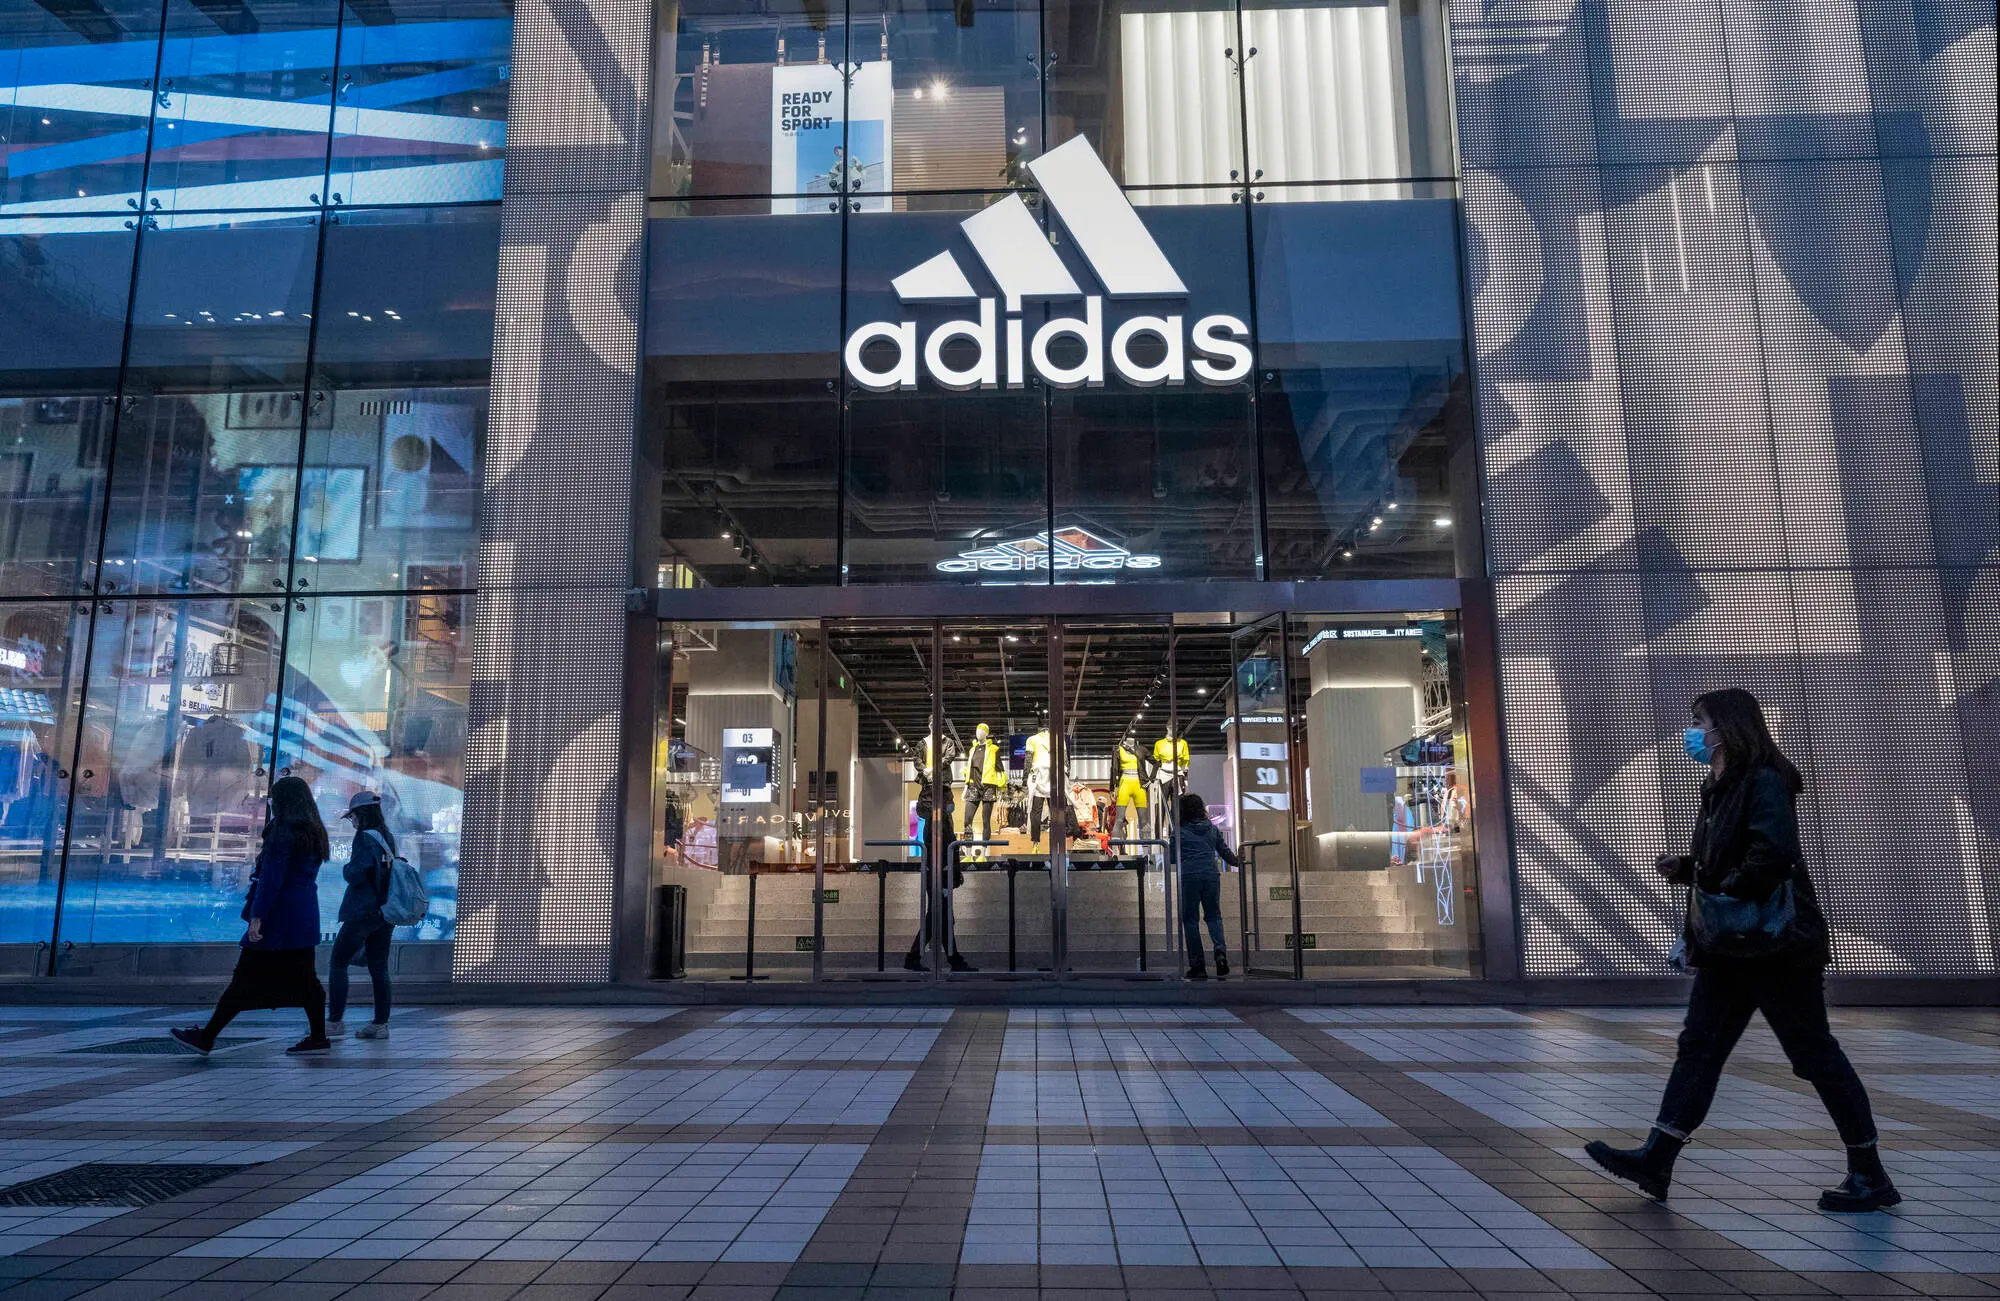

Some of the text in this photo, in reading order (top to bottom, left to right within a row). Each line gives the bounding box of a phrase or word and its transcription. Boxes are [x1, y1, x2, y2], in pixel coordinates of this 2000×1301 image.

[782, 91, 832, 105] READY
[782, 105, 811, 118] FOR
[781, 116, 832, 131] SPORT
[844, 295, 1254, 390] adidas
[936, 553, 1162, 572] adidas
[742, 733, 753, 743] 03
